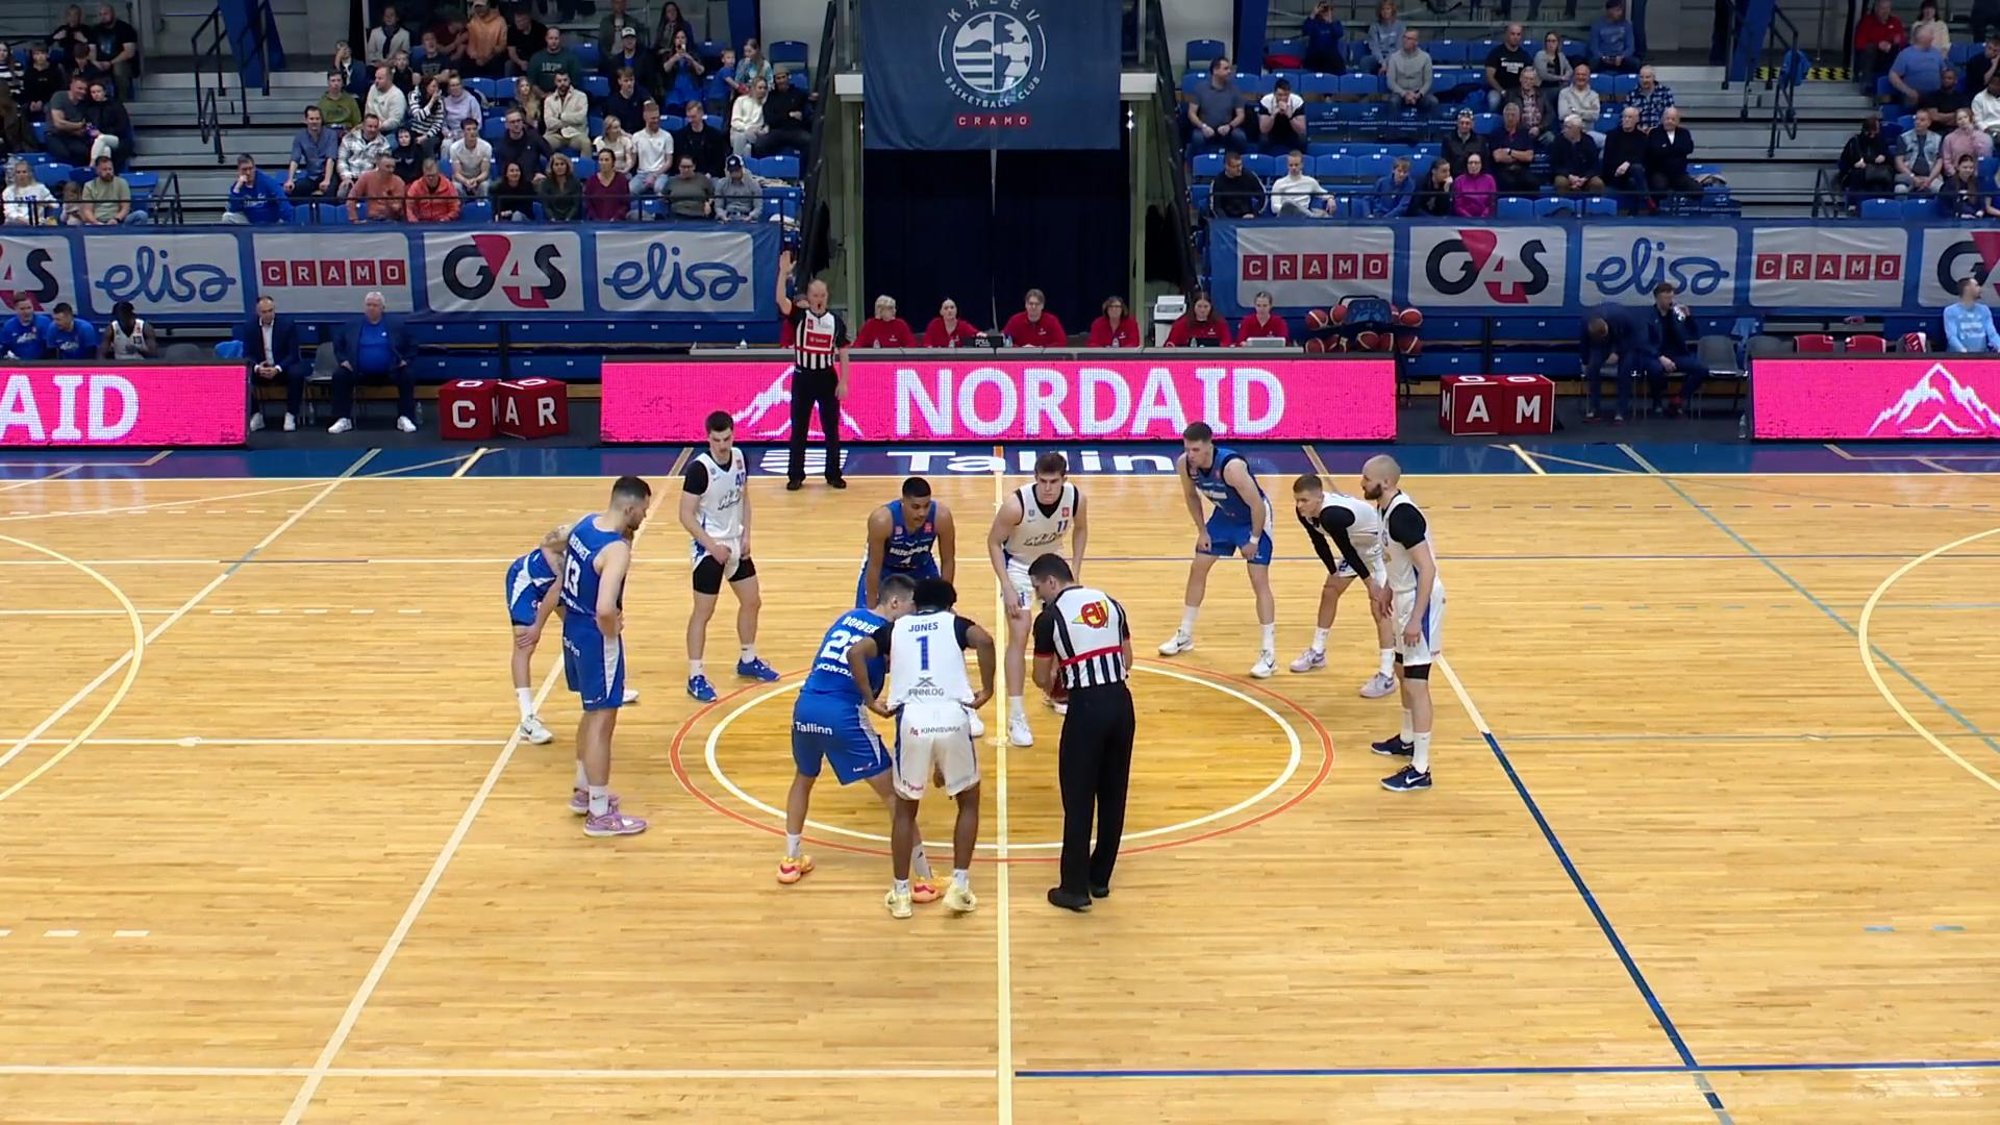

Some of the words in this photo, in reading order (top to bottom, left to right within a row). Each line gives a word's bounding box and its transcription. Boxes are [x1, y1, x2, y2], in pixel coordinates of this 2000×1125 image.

[945, 76, 1011, 108] BASKETBALL
[1018, 76, 1041, 100] CLUB
[958, 116, 1028, 126] CRAMO
[95, 245, 236, 303] elisa
[265, 264, 401, 283] CRAMO
[442, 235, 567, 308] G4S
[603, 242, 748, 301] elisa
[1246, 258, 1384, 276] CRAMO
[1425, 229, 1549, 304] G4S
[1586, 237, 1729, 295] elisa
[1760, 258, 1897, 276] CRAMO
[0, 374, 140, 440] AID
[452, 400, 476, 429] C
[537, 397, 557, 427] R
[895, 367, 1286, 437] NORDAID
[1466, 394, 1490, 423] A
[1516, 395, 1542, 424] M
[886, 450, 1177, 473] Talin
[564, 553, 581, 598] 13
[908, 622, 939, 632] JONES
[916, 635, 929, 670] 1
[795, 721, 833, 736] Tallinn
